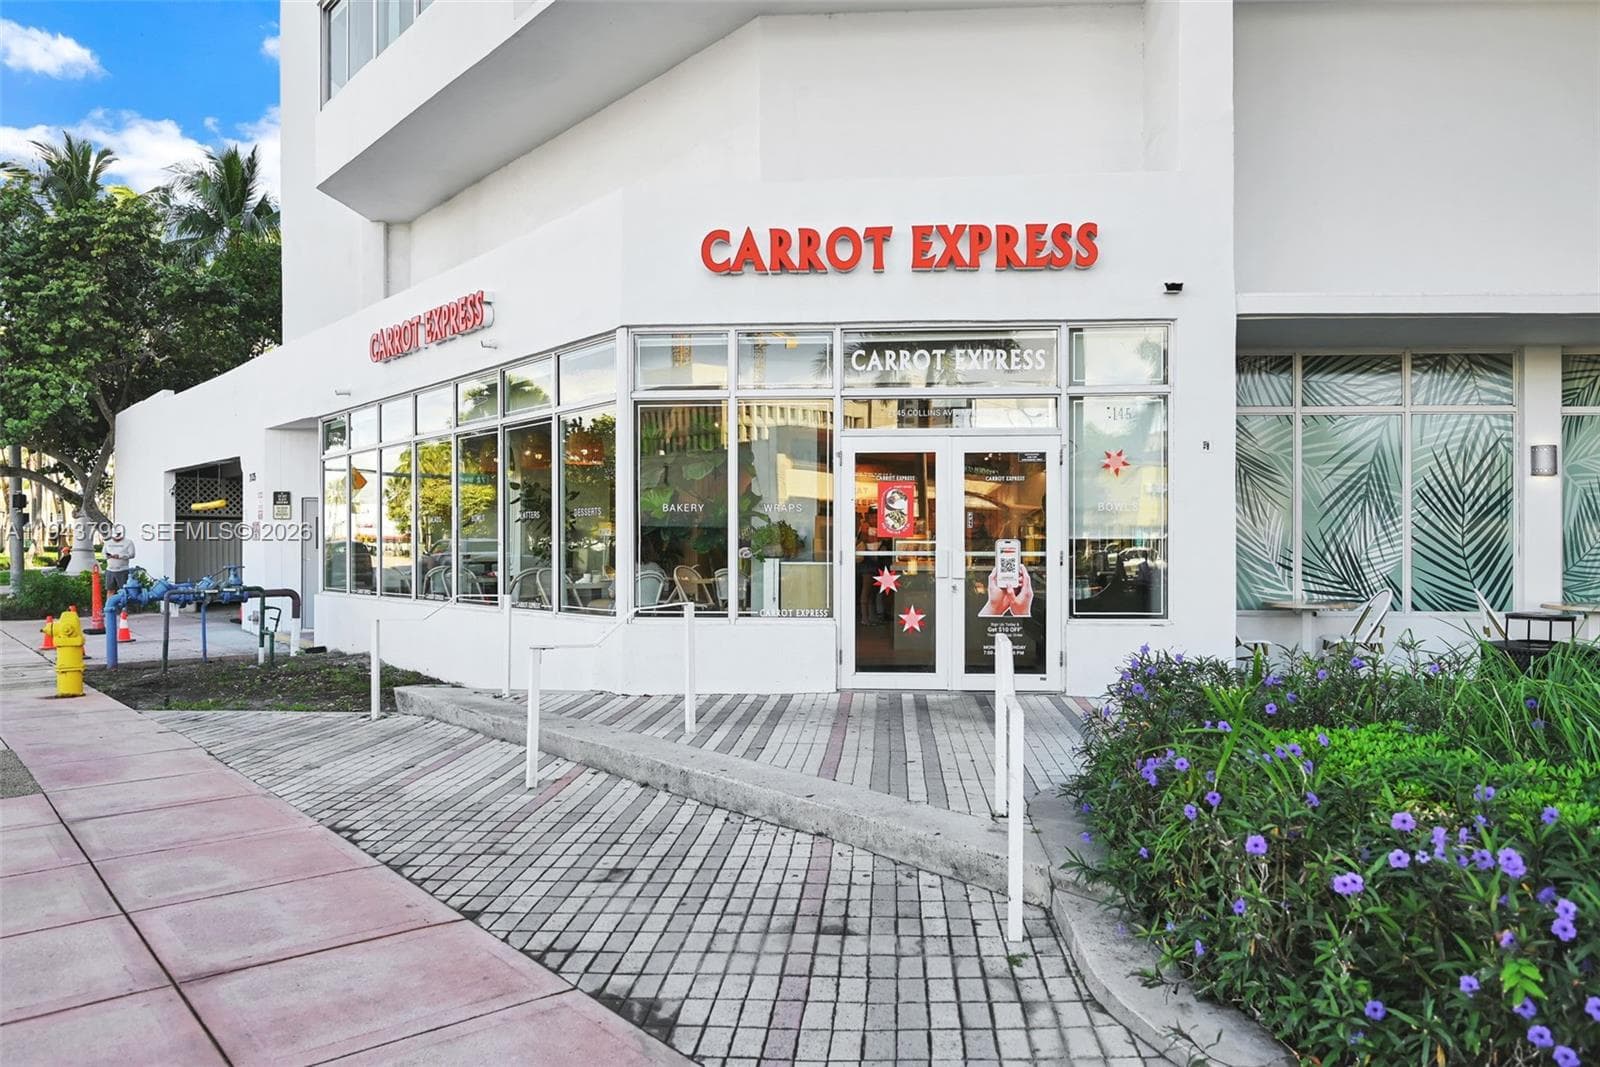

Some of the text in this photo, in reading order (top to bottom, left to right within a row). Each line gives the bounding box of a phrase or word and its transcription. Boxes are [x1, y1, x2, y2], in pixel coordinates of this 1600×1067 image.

[701, 222, 1098, 274] CARROT EXPRESS
[370, 290, 484, 363] CARROT EXPRESS
[851, 349, 1046, 371] CARROT EXPRESS
[908, 408, 941, 417] COLLINS
[573, 507, 602, 517] DESSERTS
[662, 503, 705, 512] BAKERY
[763, 503, 803, 512] WRAPS
[1097, 502, 1139, 512] BOWLS
[759, 608, 829, 618] CARROT EXPRESS
